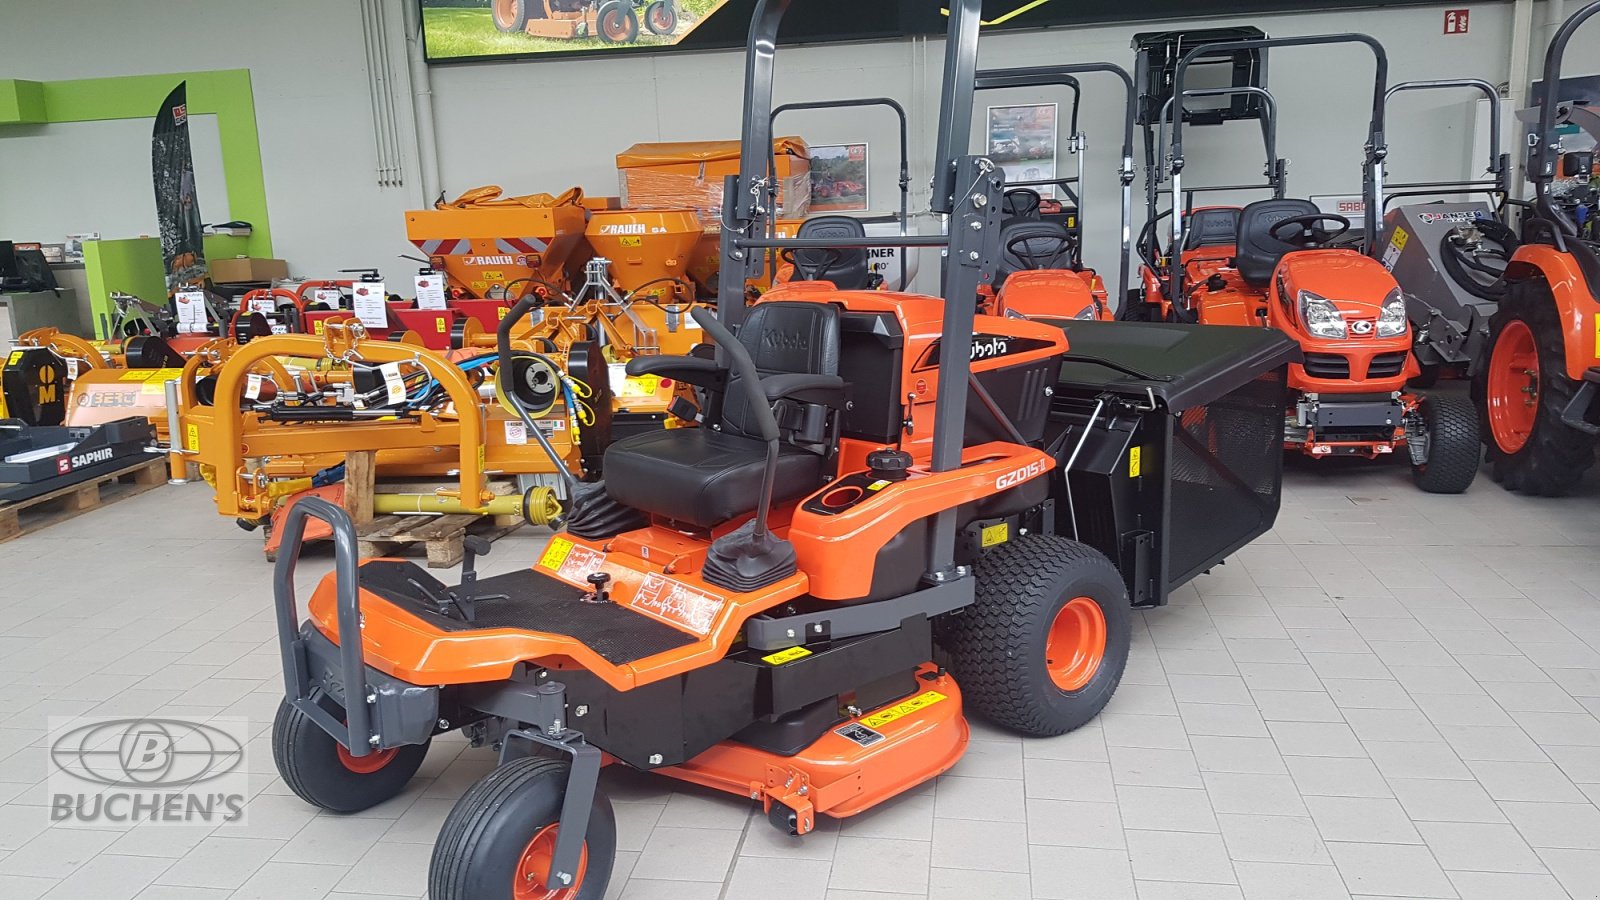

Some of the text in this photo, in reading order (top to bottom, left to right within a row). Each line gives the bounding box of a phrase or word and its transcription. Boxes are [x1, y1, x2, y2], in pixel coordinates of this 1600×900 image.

[610, 223, 646, 235] RAUCH
[477, 255, 514, 266] RAUCH
[969, 338, 1007, 360] ubota
[71, 447, 113, 468] SAPHIR
